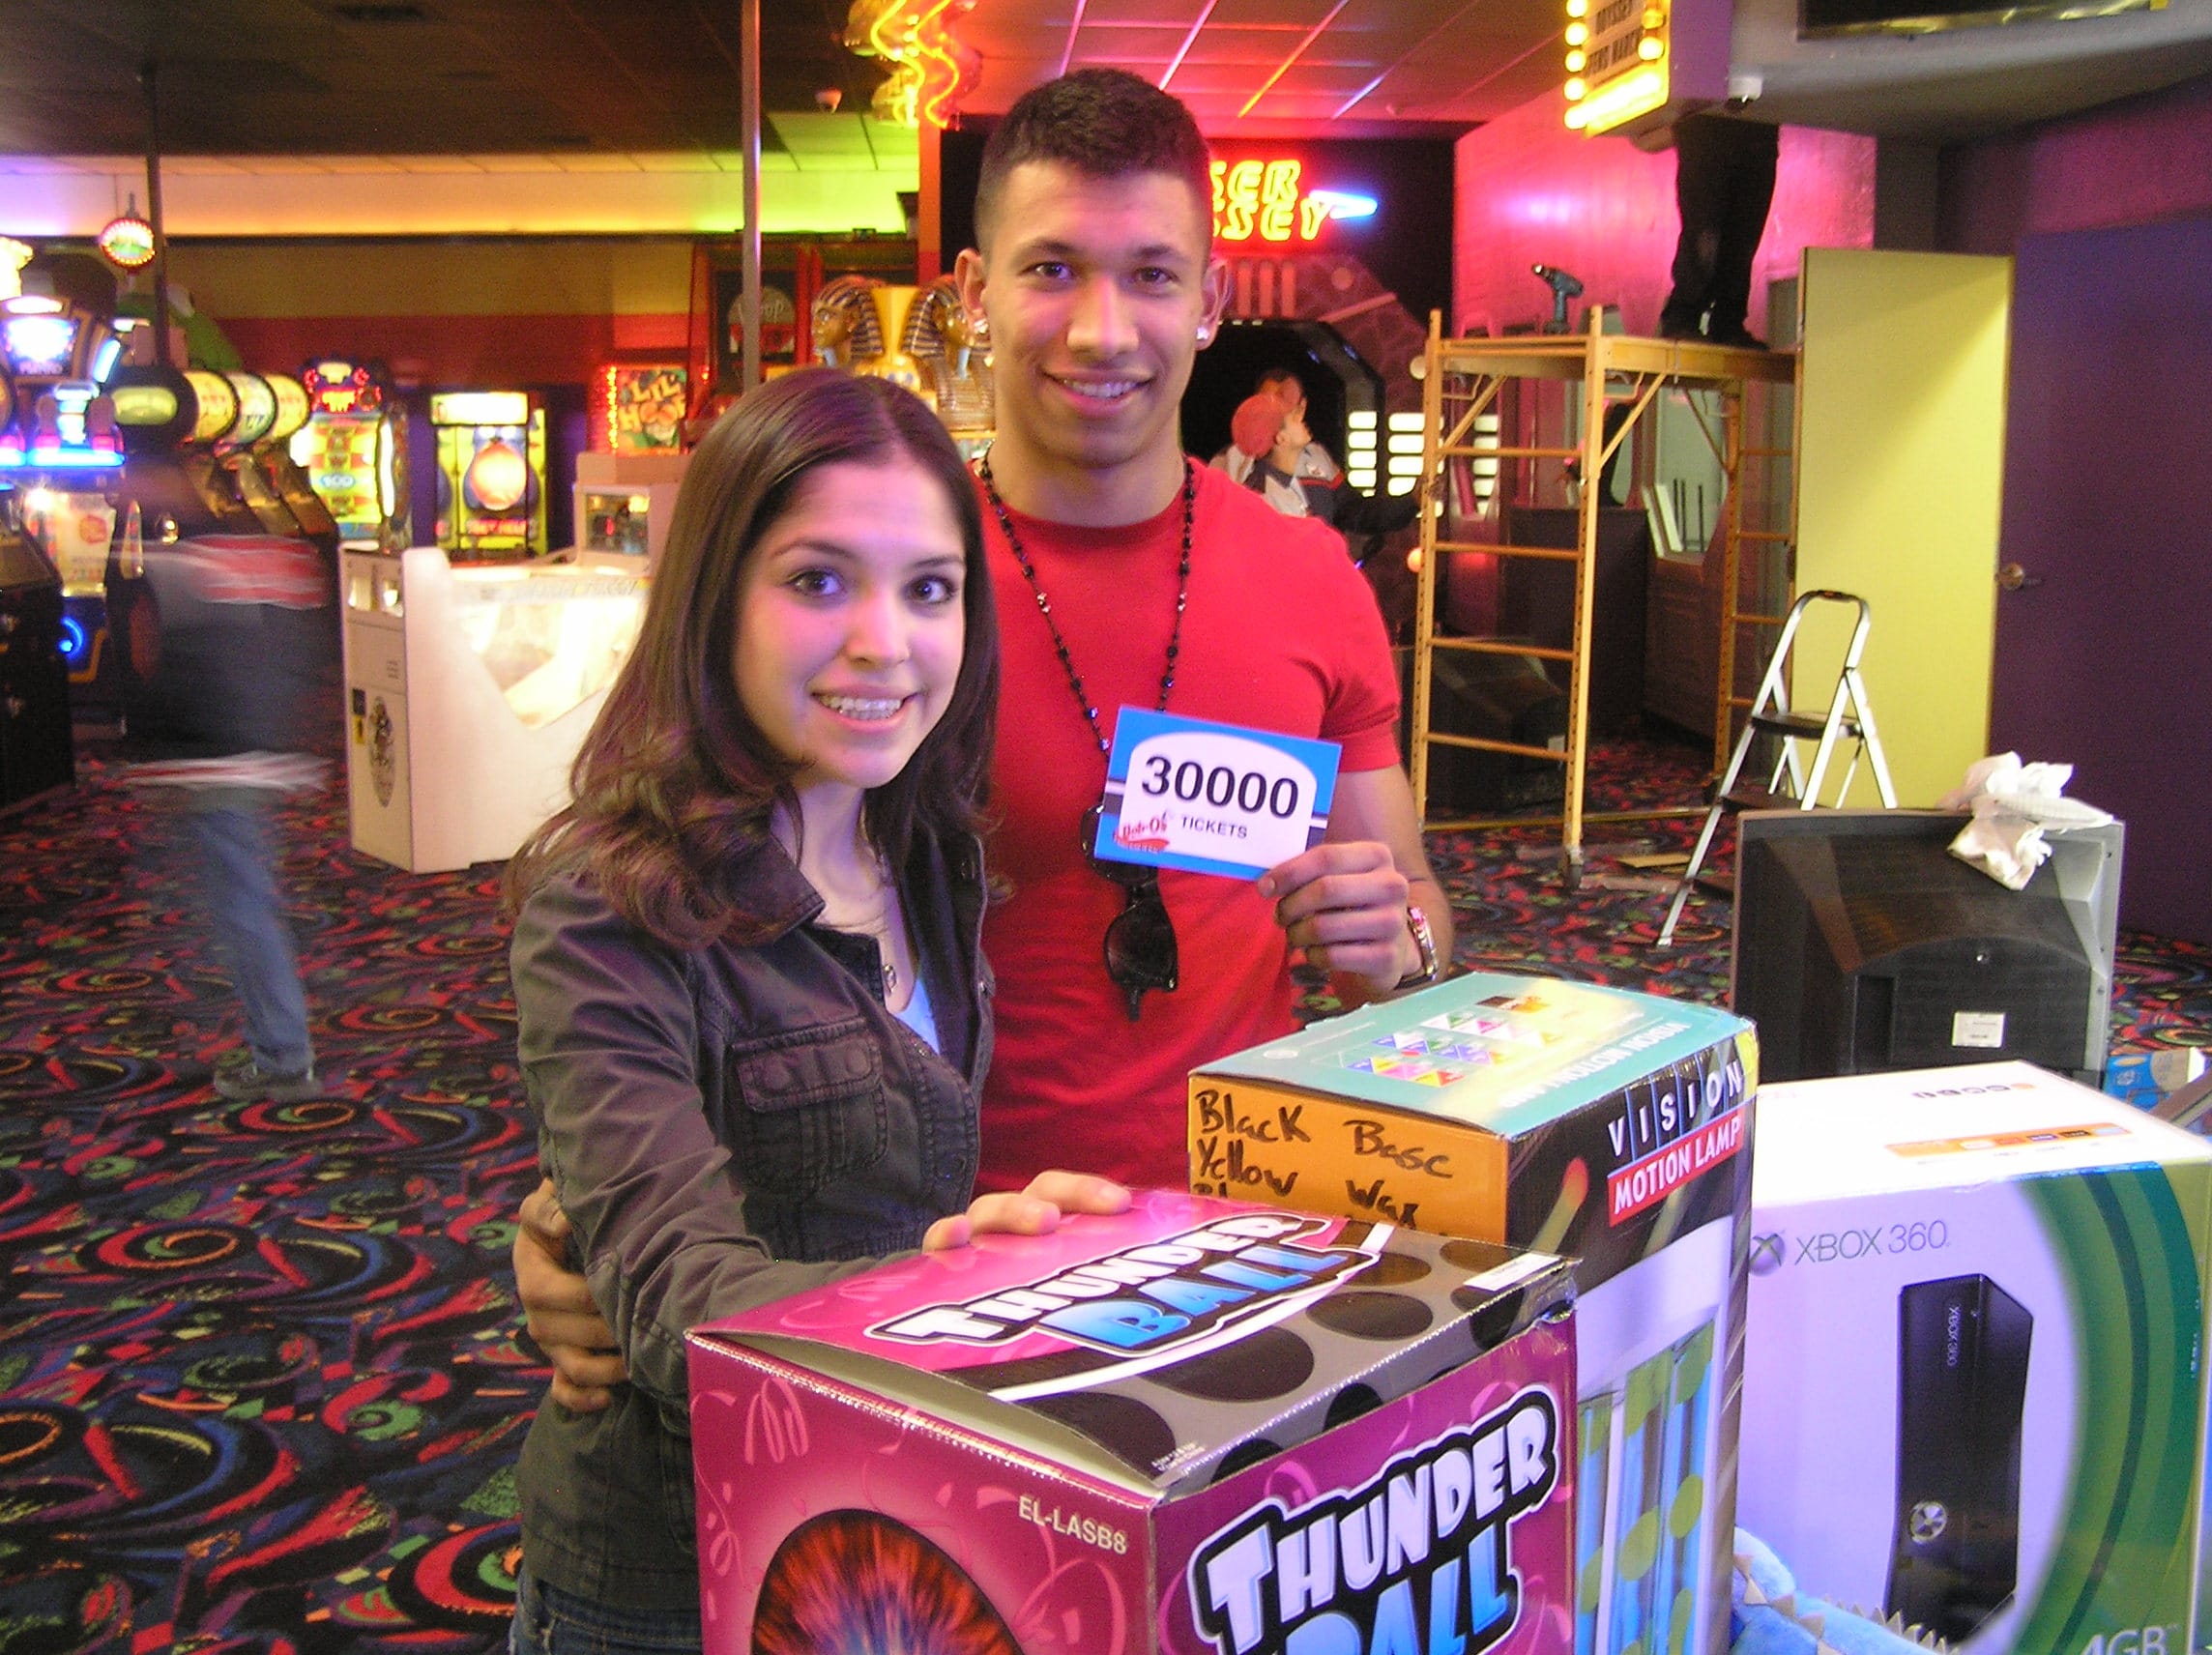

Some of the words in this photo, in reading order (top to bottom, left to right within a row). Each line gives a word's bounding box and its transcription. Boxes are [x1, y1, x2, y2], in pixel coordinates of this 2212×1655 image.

[1141, 755, 1299, 820] 30000
[1181, 815, 1248, 839] TICKETS
[1607, 1059, 1745, 1157] VISION
[1614, 1143, 1691, 1215] MOTION
[1694, 1115, 1743, 1169] LAMP
[884, 1215, 1307, 1340] THUNDER
[1793, 1227, 1883, 1266] XBOX
[1887, 1219, 1948, 1255] 360
[1039, 1245, 1349, 1349] BALL
[1946, 1304, 1963, 1342] XBOX
[1018, 1495, 1128, 1555] EL-LASB8
[1206, 1406, 1548, 1655] THUNDER
